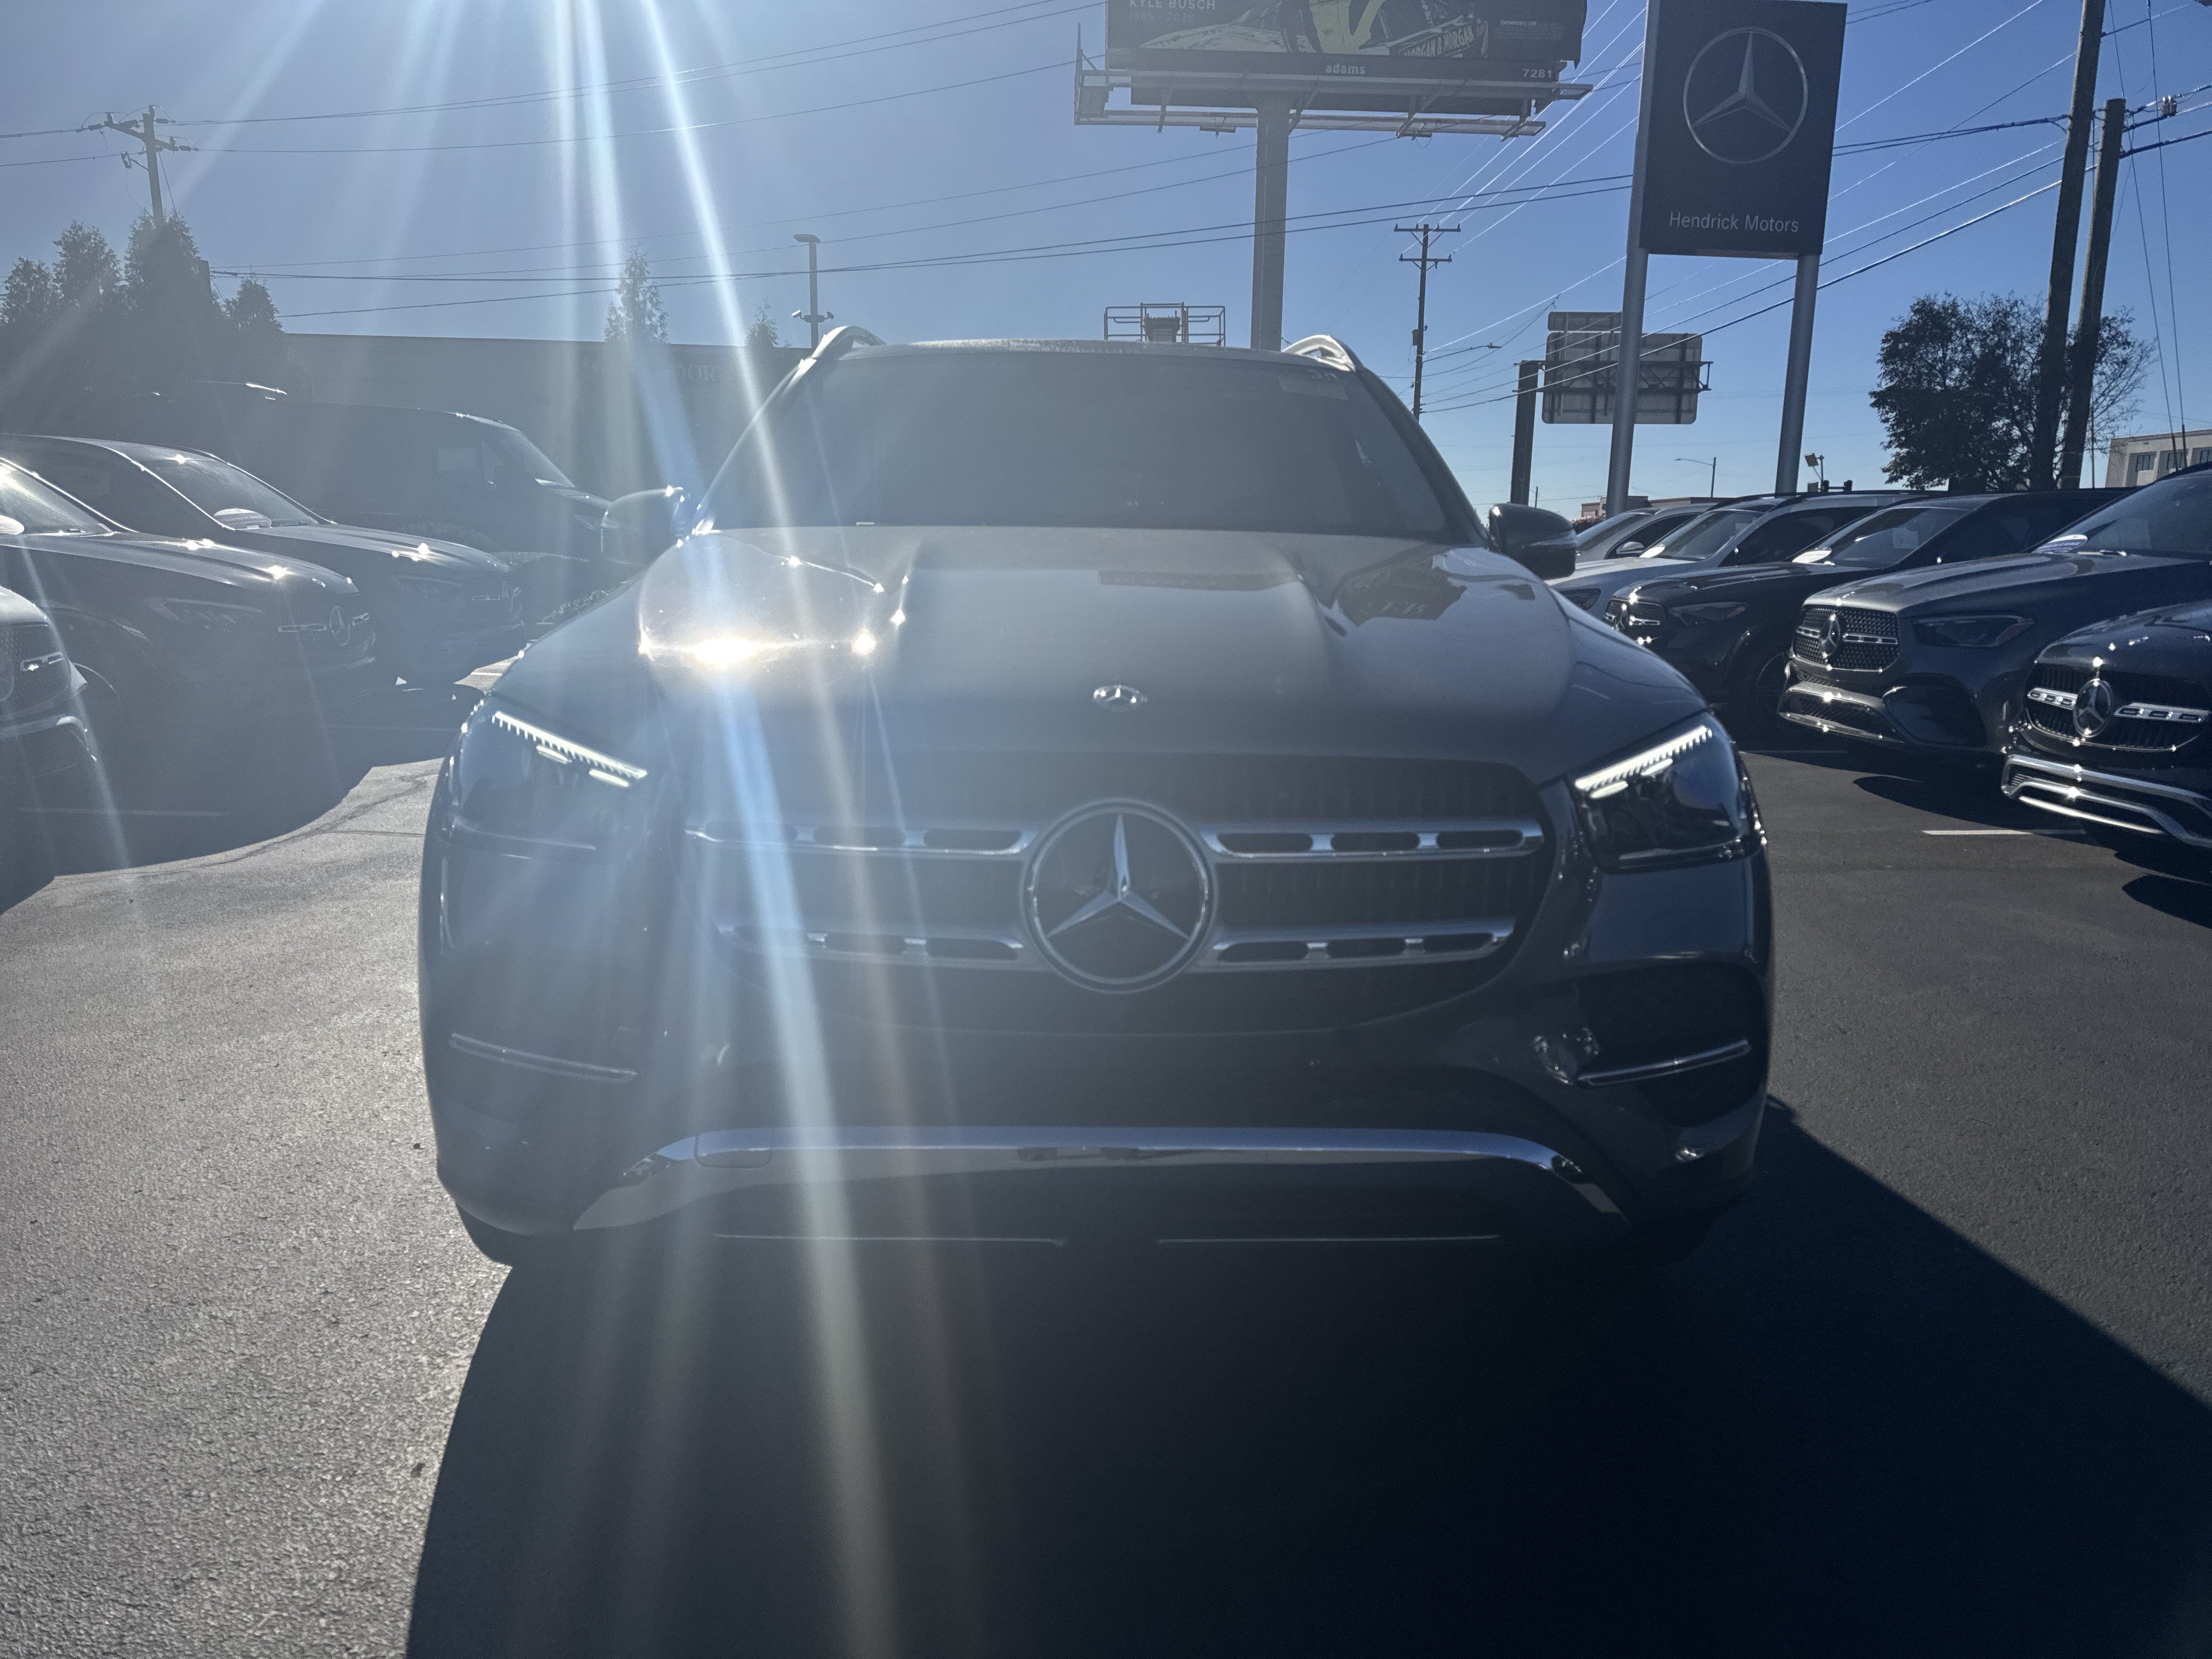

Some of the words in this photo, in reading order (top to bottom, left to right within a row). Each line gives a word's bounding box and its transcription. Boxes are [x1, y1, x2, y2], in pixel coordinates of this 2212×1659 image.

[1130, 0, 1163, 8] KYLE
[1169, 0, 1215, 10] BUSCH
[1443, 25, 1475, 51] MORGAN
[1325, 63, 1366, 75] adams
[1522, 68, 1552, 78] 7281
[1669, 211, 1739, 230] Hendrick
[1745, 215, 1799, 233] Motors
